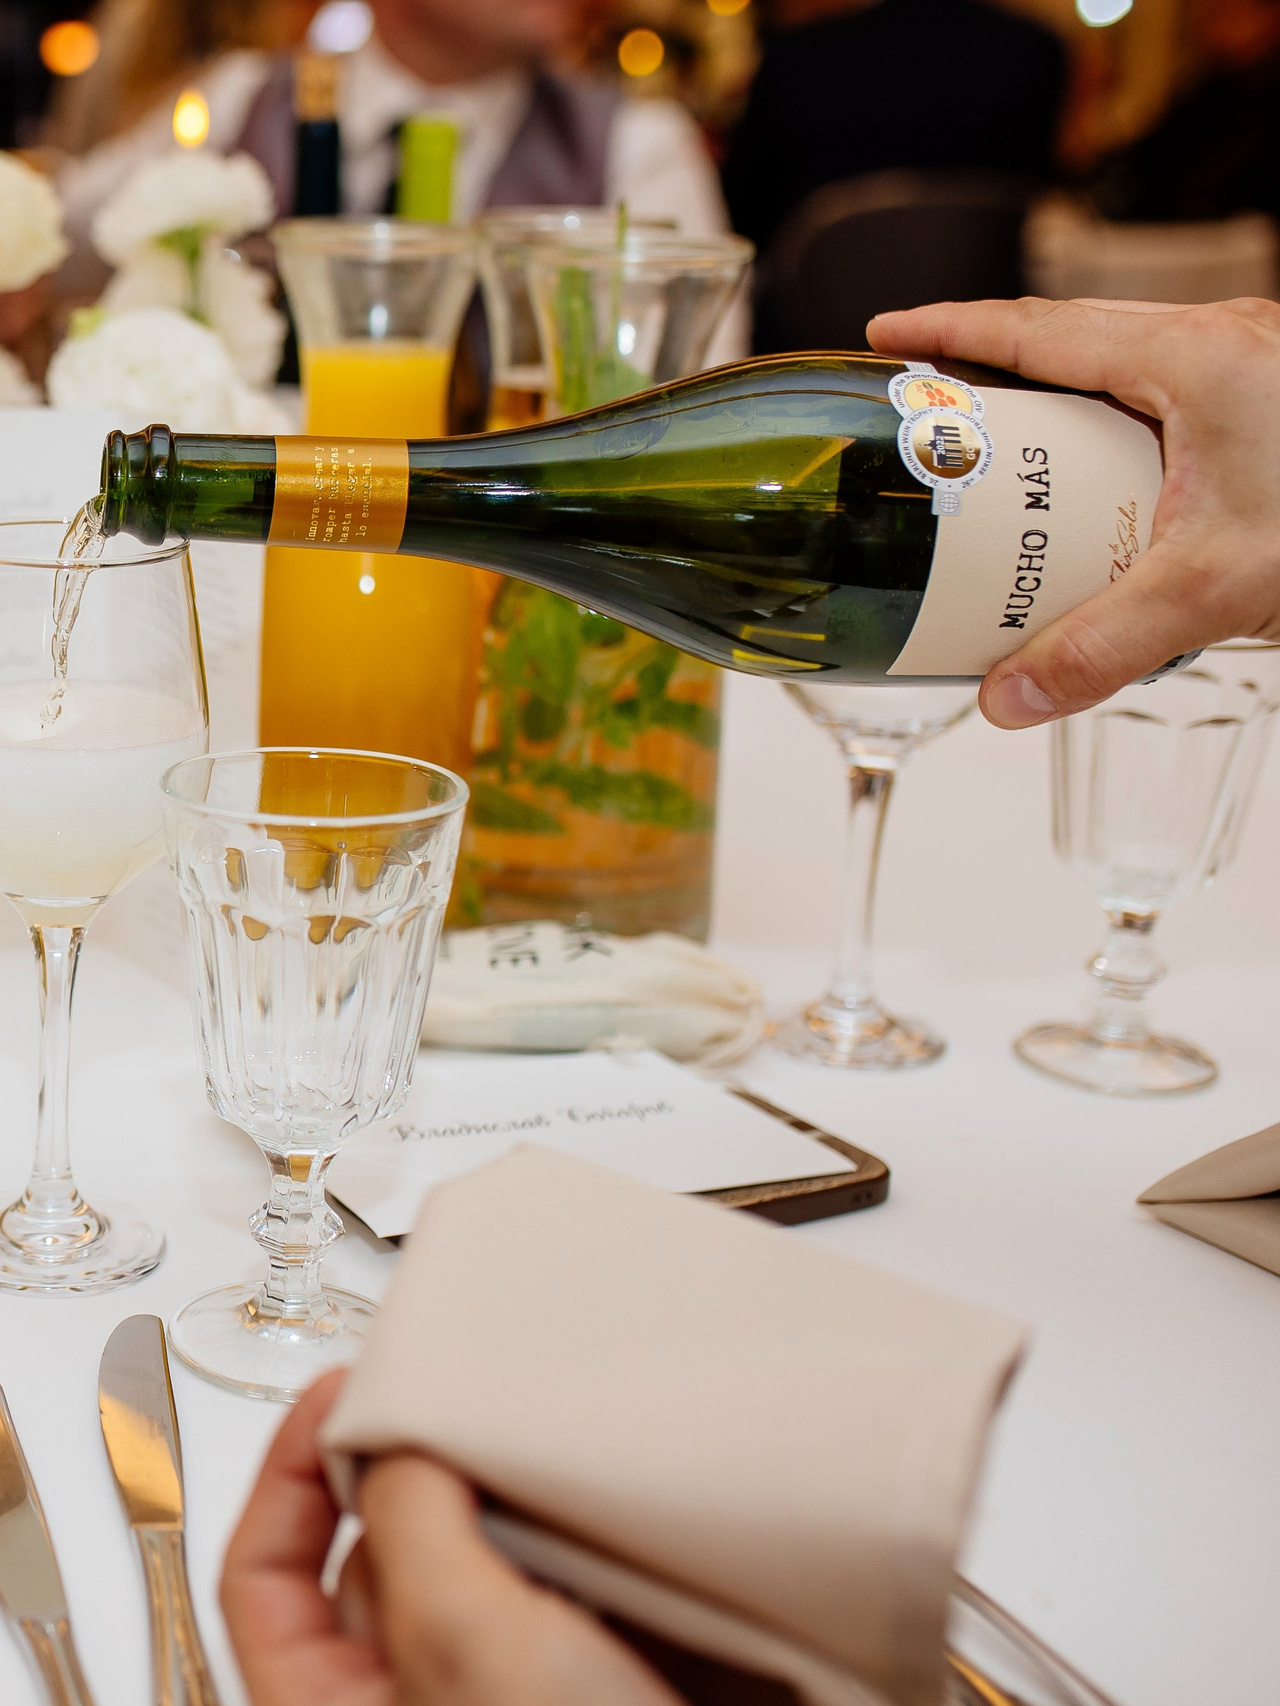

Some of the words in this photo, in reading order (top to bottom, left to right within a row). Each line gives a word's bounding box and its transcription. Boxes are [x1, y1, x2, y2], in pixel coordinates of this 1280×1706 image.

[965, 387, 977, 399] the
[908, 408, 933, 425] TROPHY
[954, 410, 983, 430] TROPHY
[902, 426, 911, 443] WEIN
[981, 431, 993, 450] WINE
[935, 435, 946, 455] 2022
[903, 446, 927, 479] BERLINER
[979, 451, 993, 476] BERLIN
[1017, 446, 1050, 511] MÁS
[323, 507, 337, 542] romper
[337, 513, 352, 543] hasta
[355, 525, 367, 537] lo
[999, 529, 1048, 629] MUCHO
